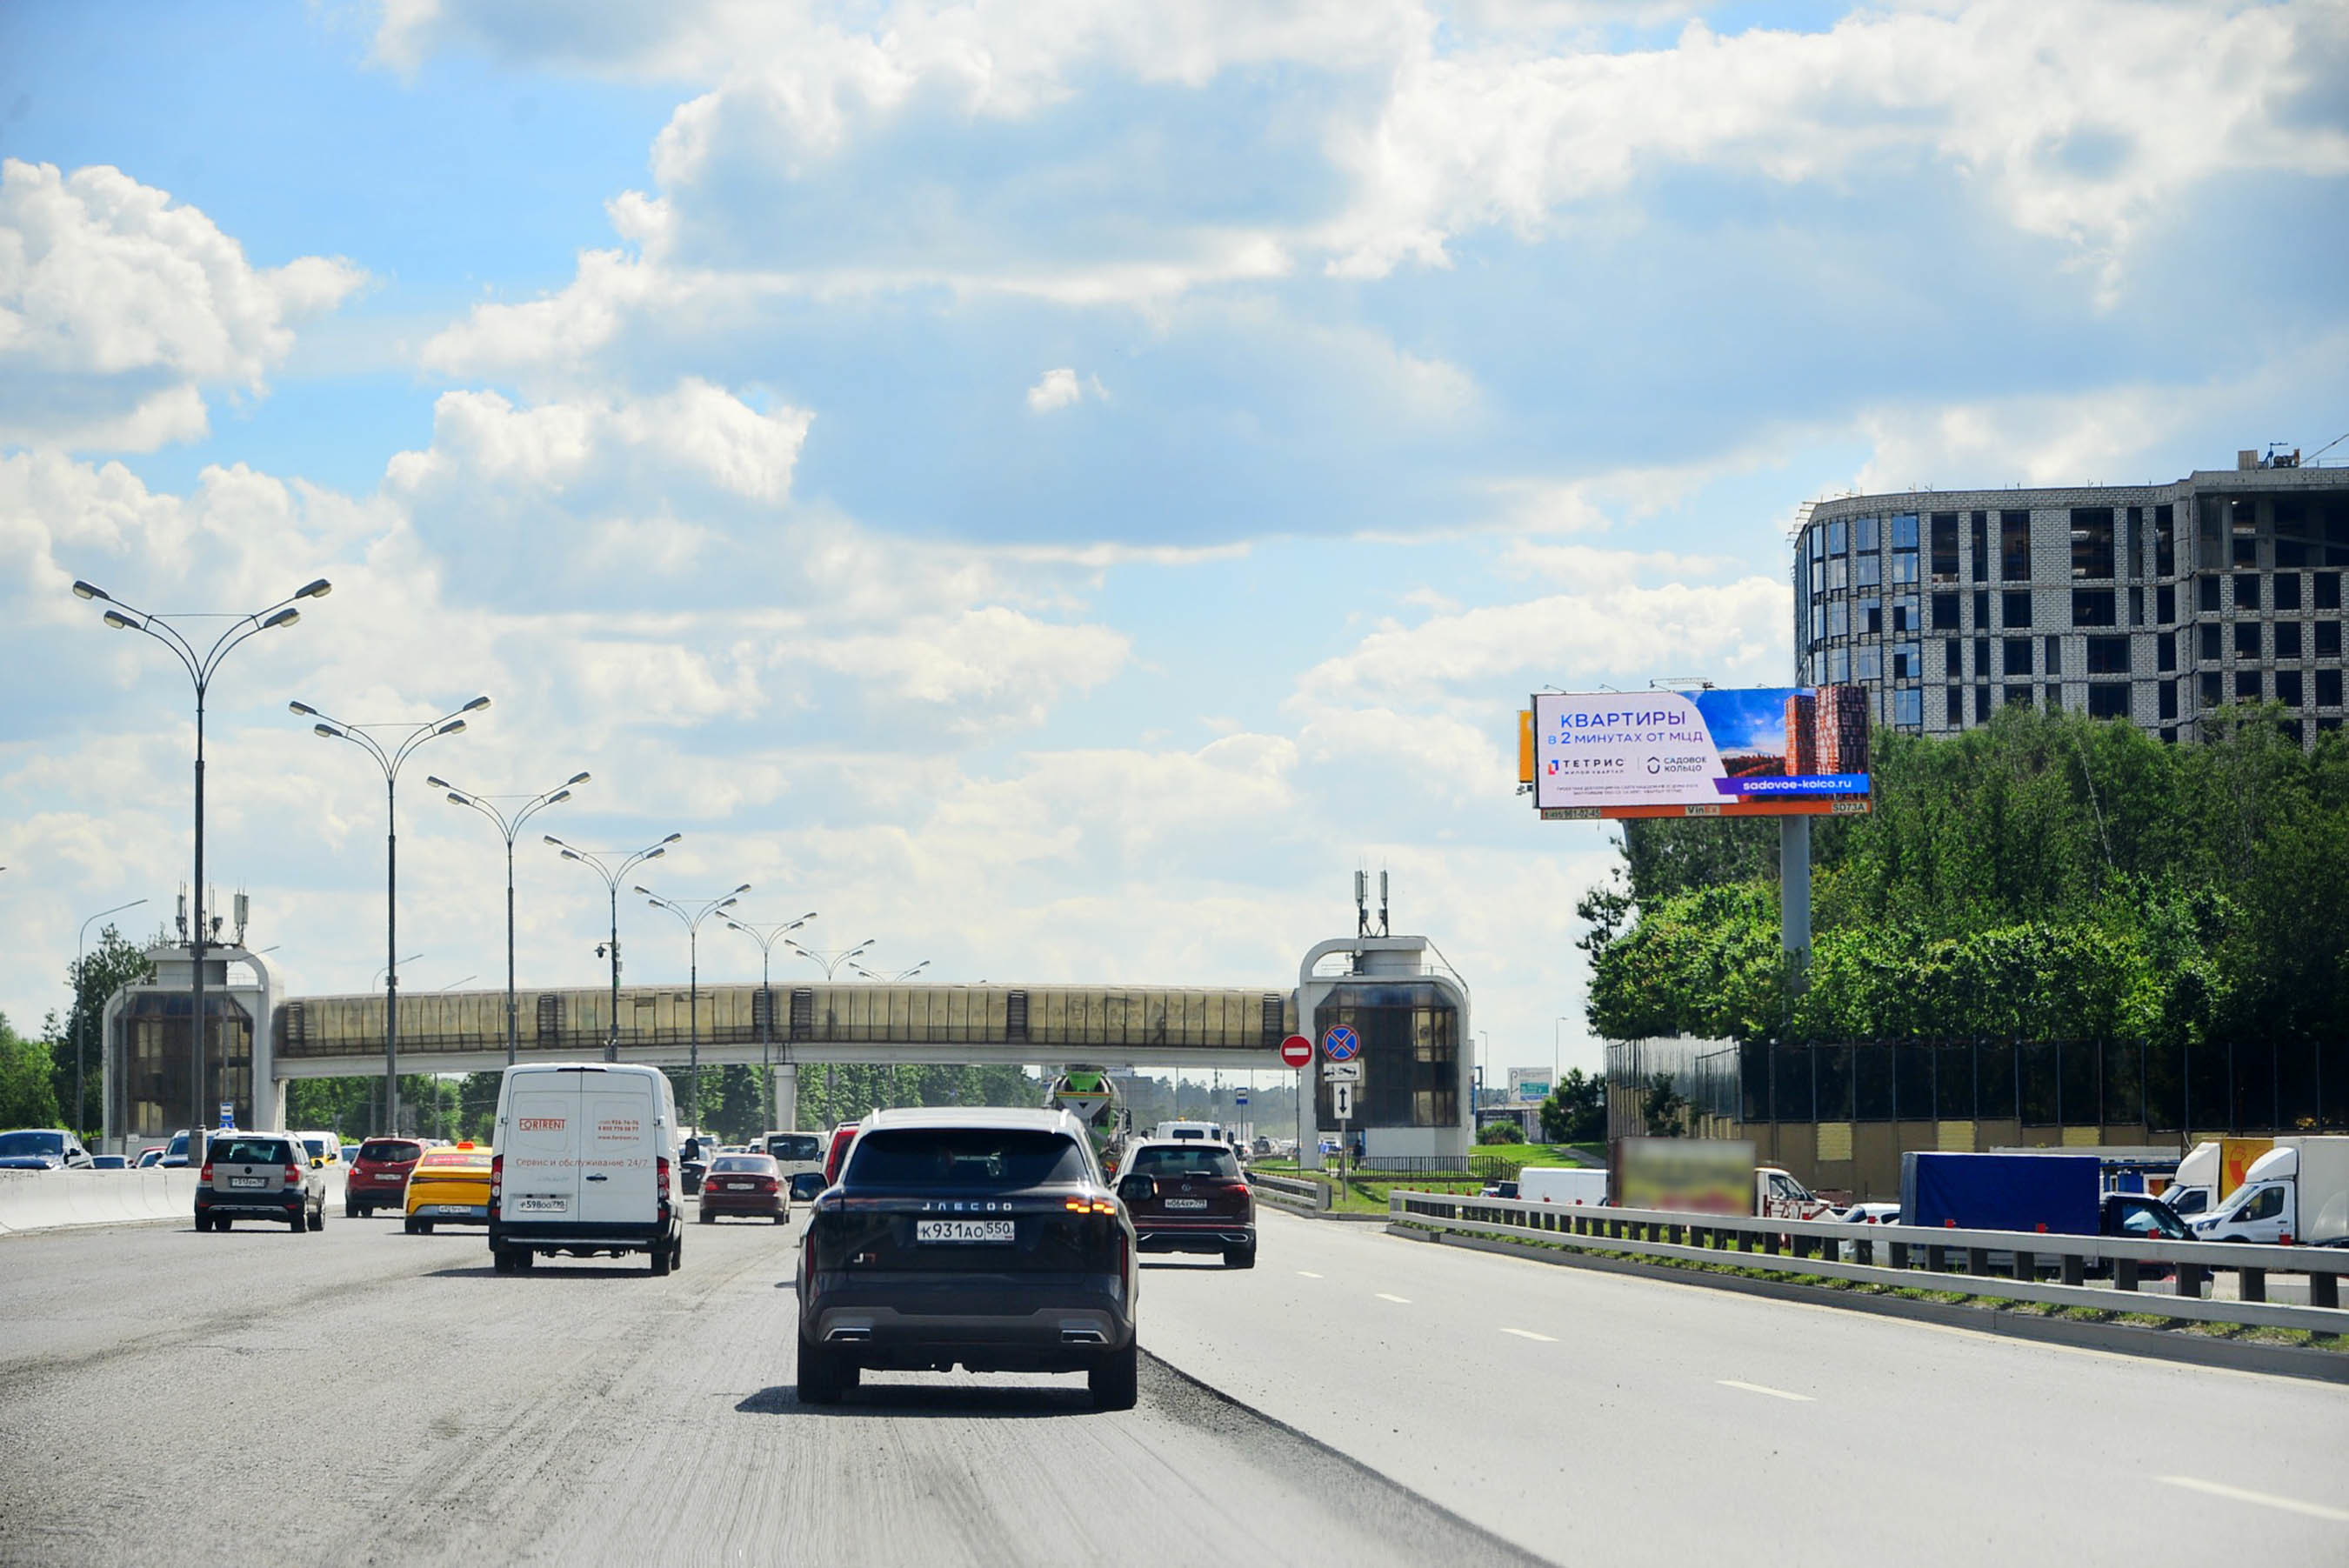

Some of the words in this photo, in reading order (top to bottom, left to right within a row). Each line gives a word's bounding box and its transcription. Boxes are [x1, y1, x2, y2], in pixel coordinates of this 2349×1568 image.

[1560, 711, 1686, 729] КВАРТИРЫ
[1560, 731, 1572, 744] 2
[1574, 732, 1643, 744] МИНУТАХ
[1646, 731, 1665, 743] ОТ
[1669, 731, 1705, 743] МЦД
[1563, 758, 1625, 768] ТЕТРИС
[1663, 756, 1707, 765] САДОВОЕ
[1663, 764, 1703, 773] КОЛЬЦО
[1743, 779, 1852, 791] sadovoe-kolco.ru
[519, 1118, 565, 1131] FORTRENT
[516, 1158, 547, 1168] Сервис
[558, 1158, 624, 1168] обслуживание
[627, 1158, 648, 1169] 24/7
[921, 1202, 1013, 1211] JAECOO
